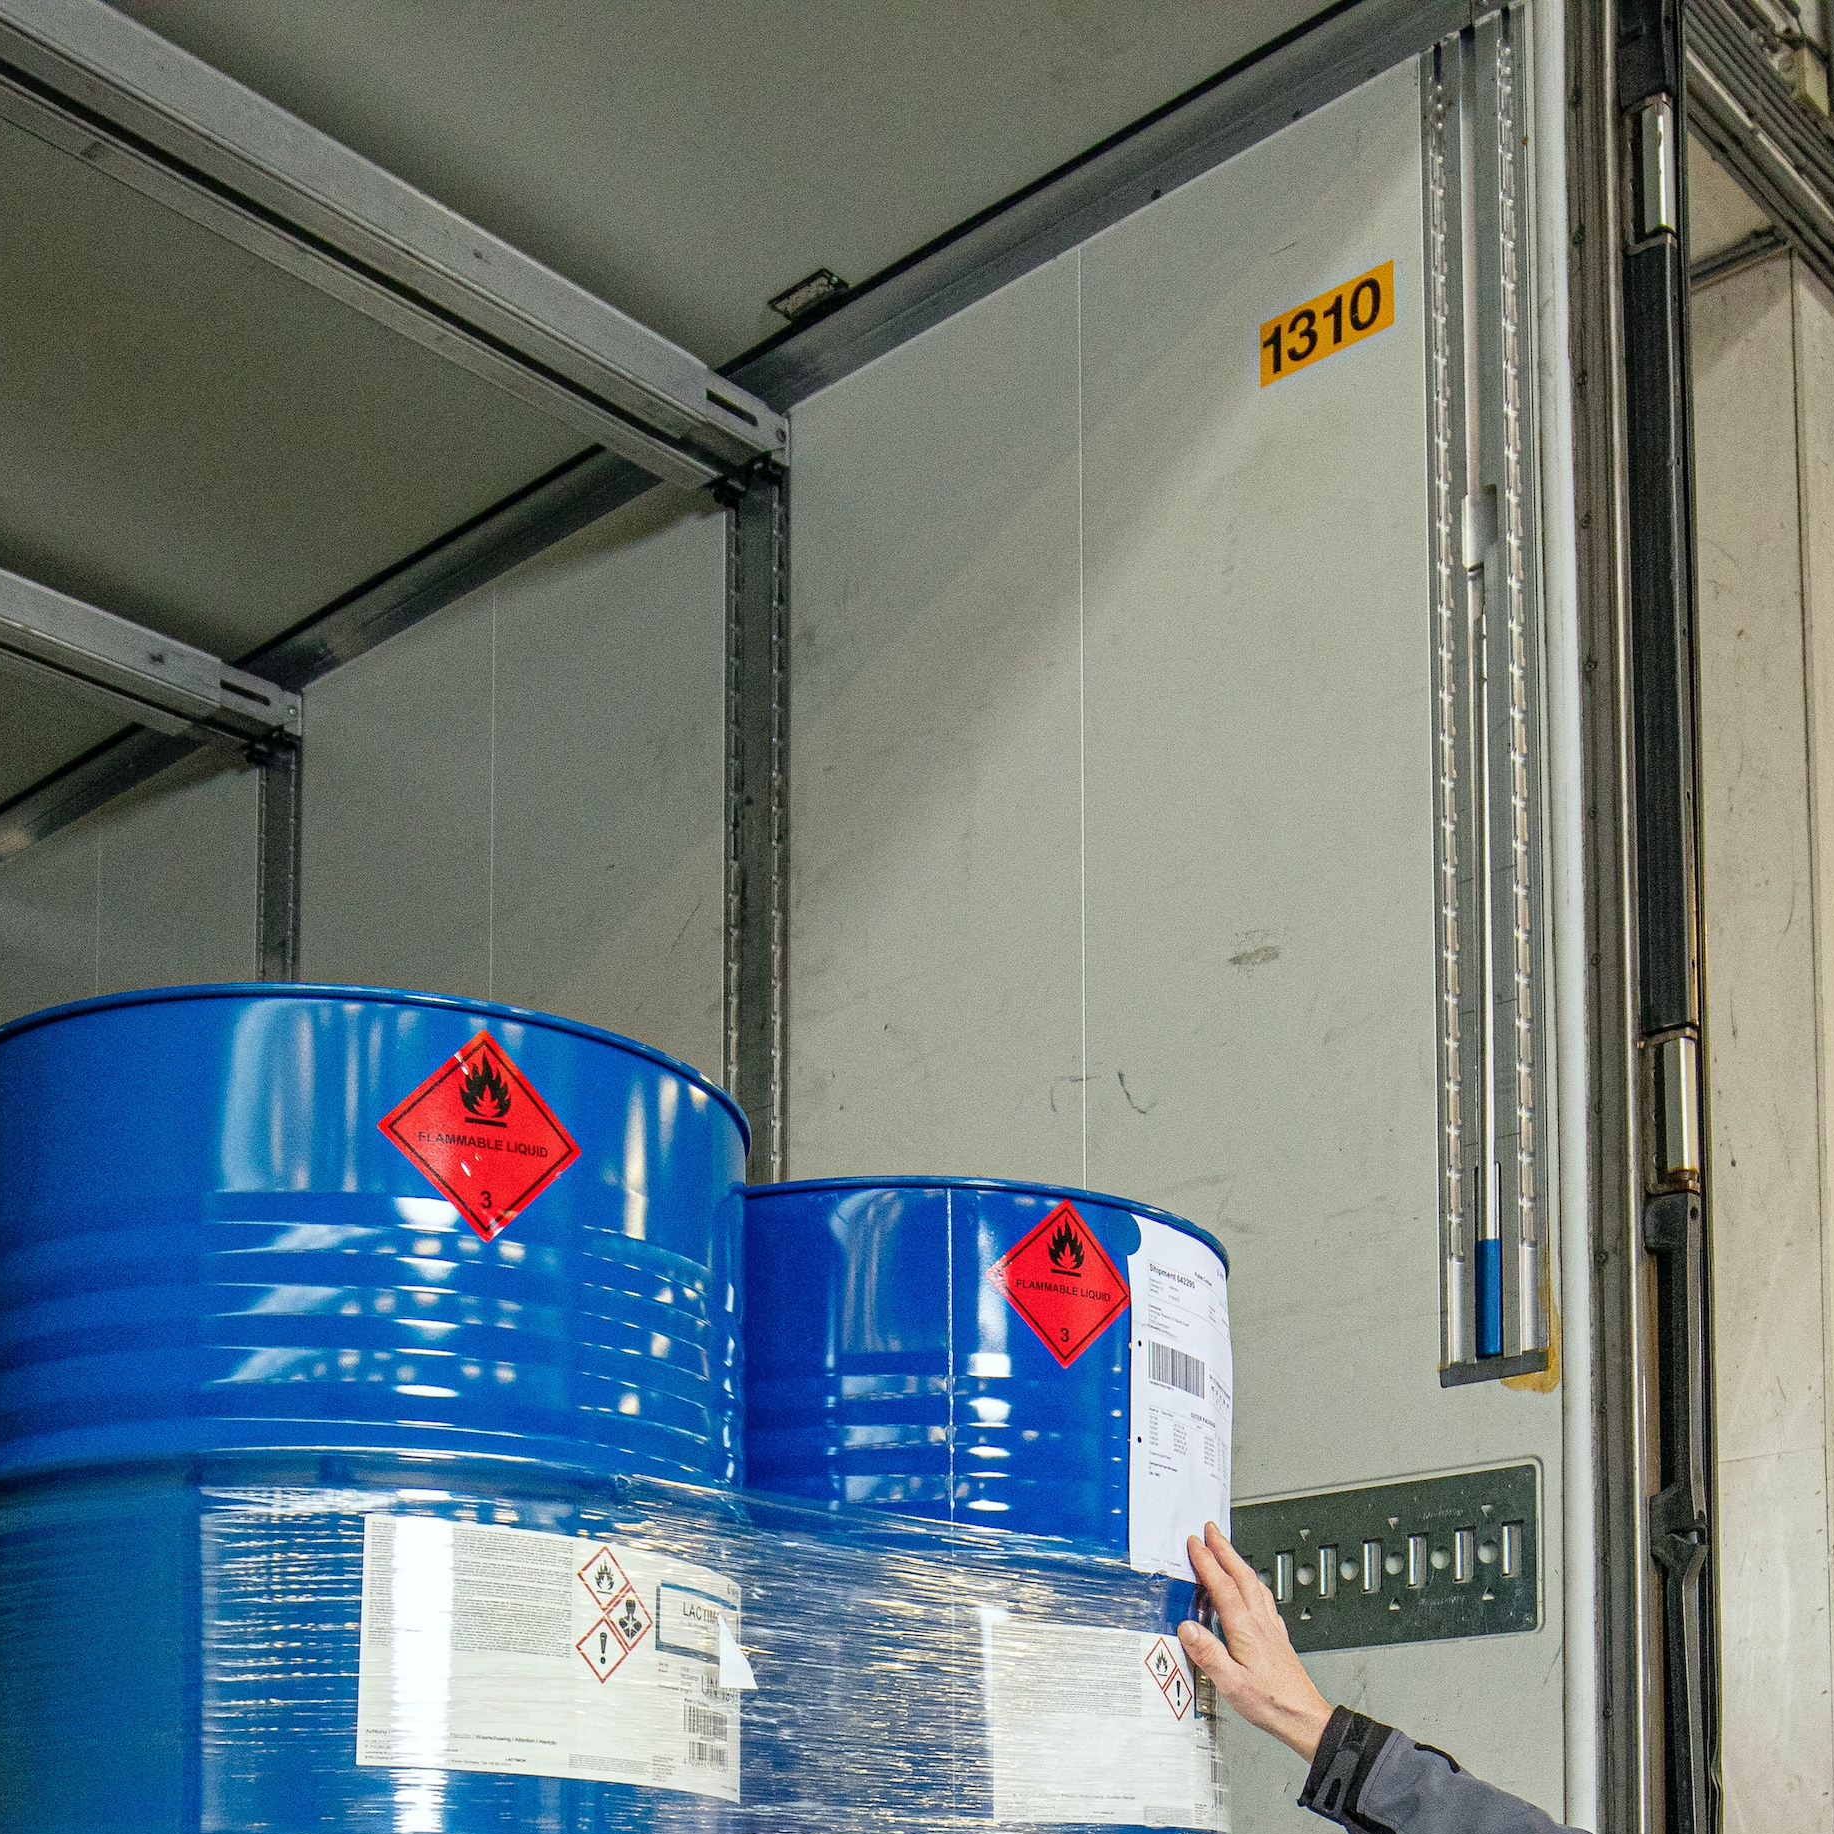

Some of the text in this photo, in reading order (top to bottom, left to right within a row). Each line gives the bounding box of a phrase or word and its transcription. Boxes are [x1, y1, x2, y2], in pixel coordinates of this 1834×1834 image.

[1262, 277, 1381, 374] 1310
[418, 1131, 548, 1158] FLAMMABLE LIQUID
[480, 1190, 492, 1209] 3
[1016, 1279, 1111, 1302] FLAMMABLE LIQUID
[1060, 1327, 1070, 1343] 3
[683, 1602, 720, 1623] LACTIM
[365, 1728, 387, 1736] Achtung
[475, 1734, 512, 1742] Waarschuwing
